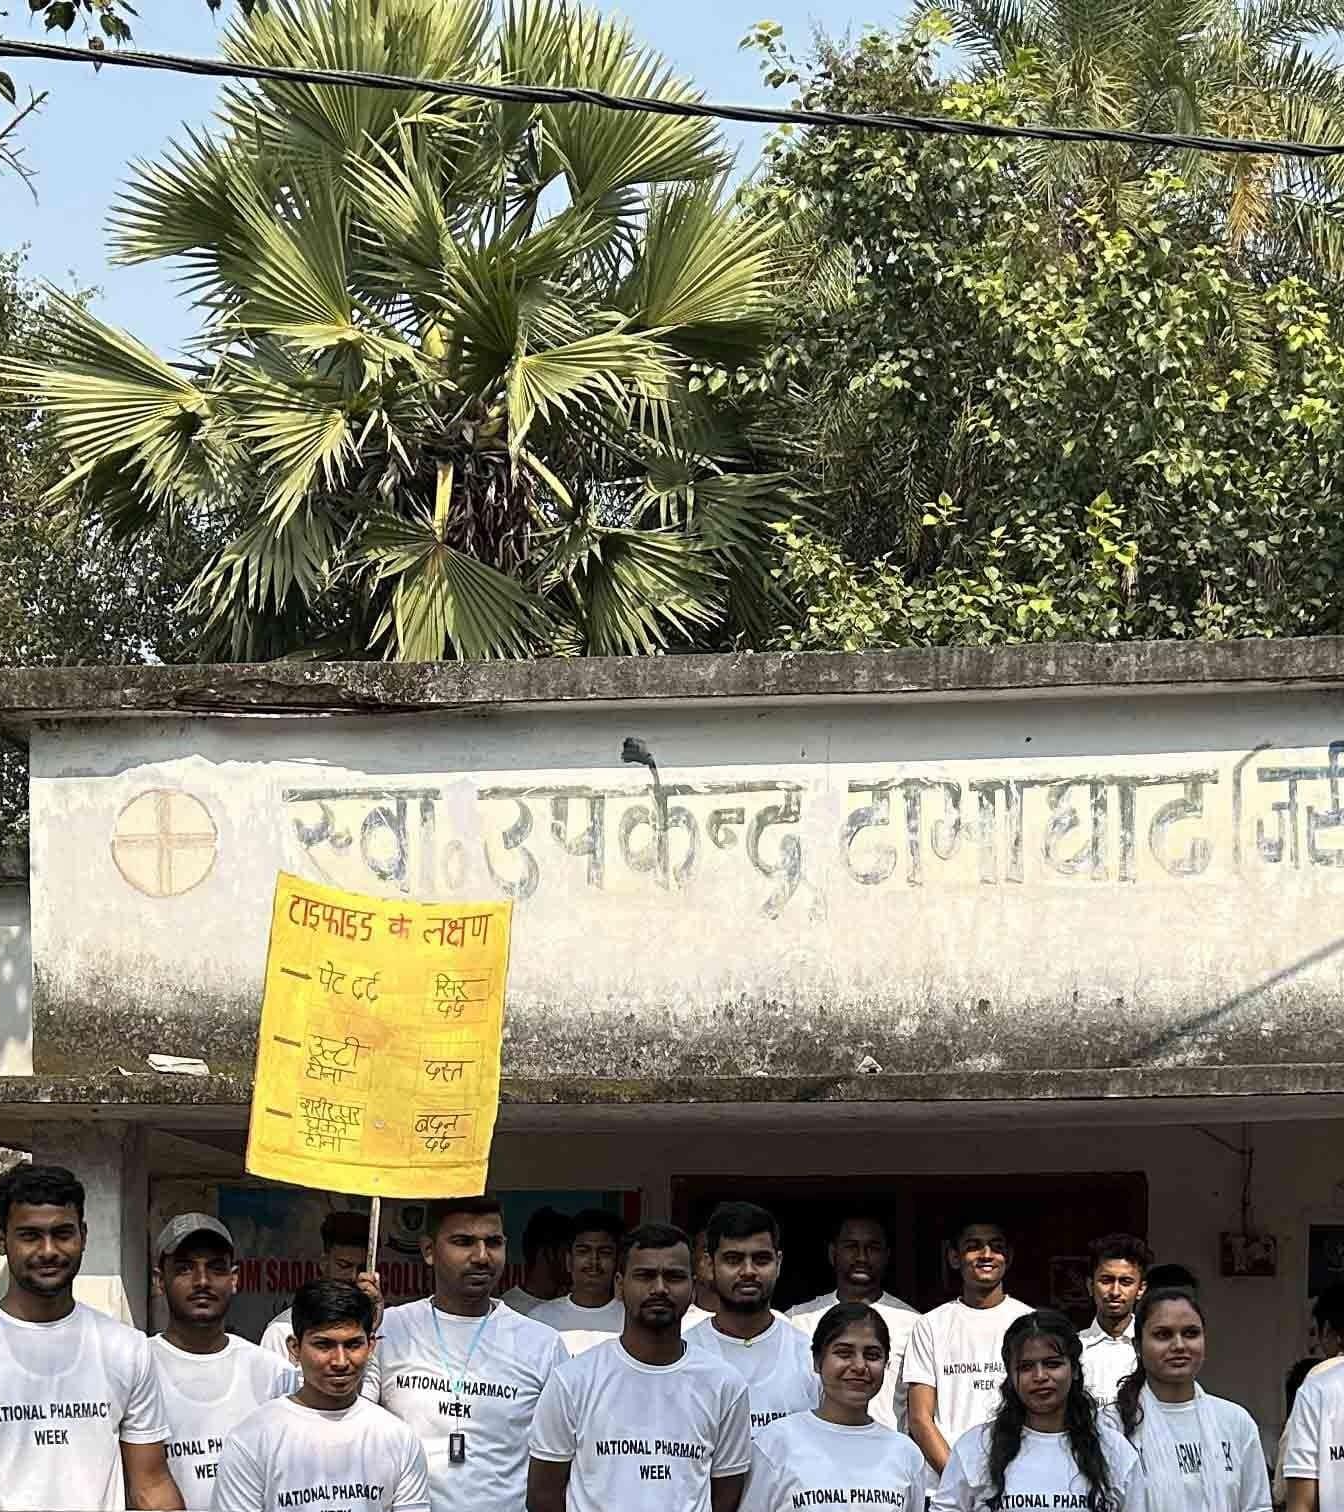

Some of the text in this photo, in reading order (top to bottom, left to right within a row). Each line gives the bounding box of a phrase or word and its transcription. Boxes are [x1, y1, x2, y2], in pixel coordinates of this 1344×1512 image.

[288, 893, 493, 947] टाइफाइड के लक्षण
[319, 960, 348, 995] पेट
[943, 1363, 982, 1376] NATIONAL
[397, 1375, 452, 1393] NATIONAL
[973, 1379, 995, 1391] WEEK
[49, 1401, 112, 1420] PHARMACY
[438, 1401, 472, 1418] WEEK
[34, 1428, 70, 1446] WEEK
[164, 1440, 205, 1458] TIONAL
[596, 1438, 706, 1460] NATIONAL PHARMACY
[639, 1463, 672, 1481] WEEK
[277, 1485, 330, 1508] NATIONAL
[792, 1487, 906, 1509] NATIONAL PHARMACY
